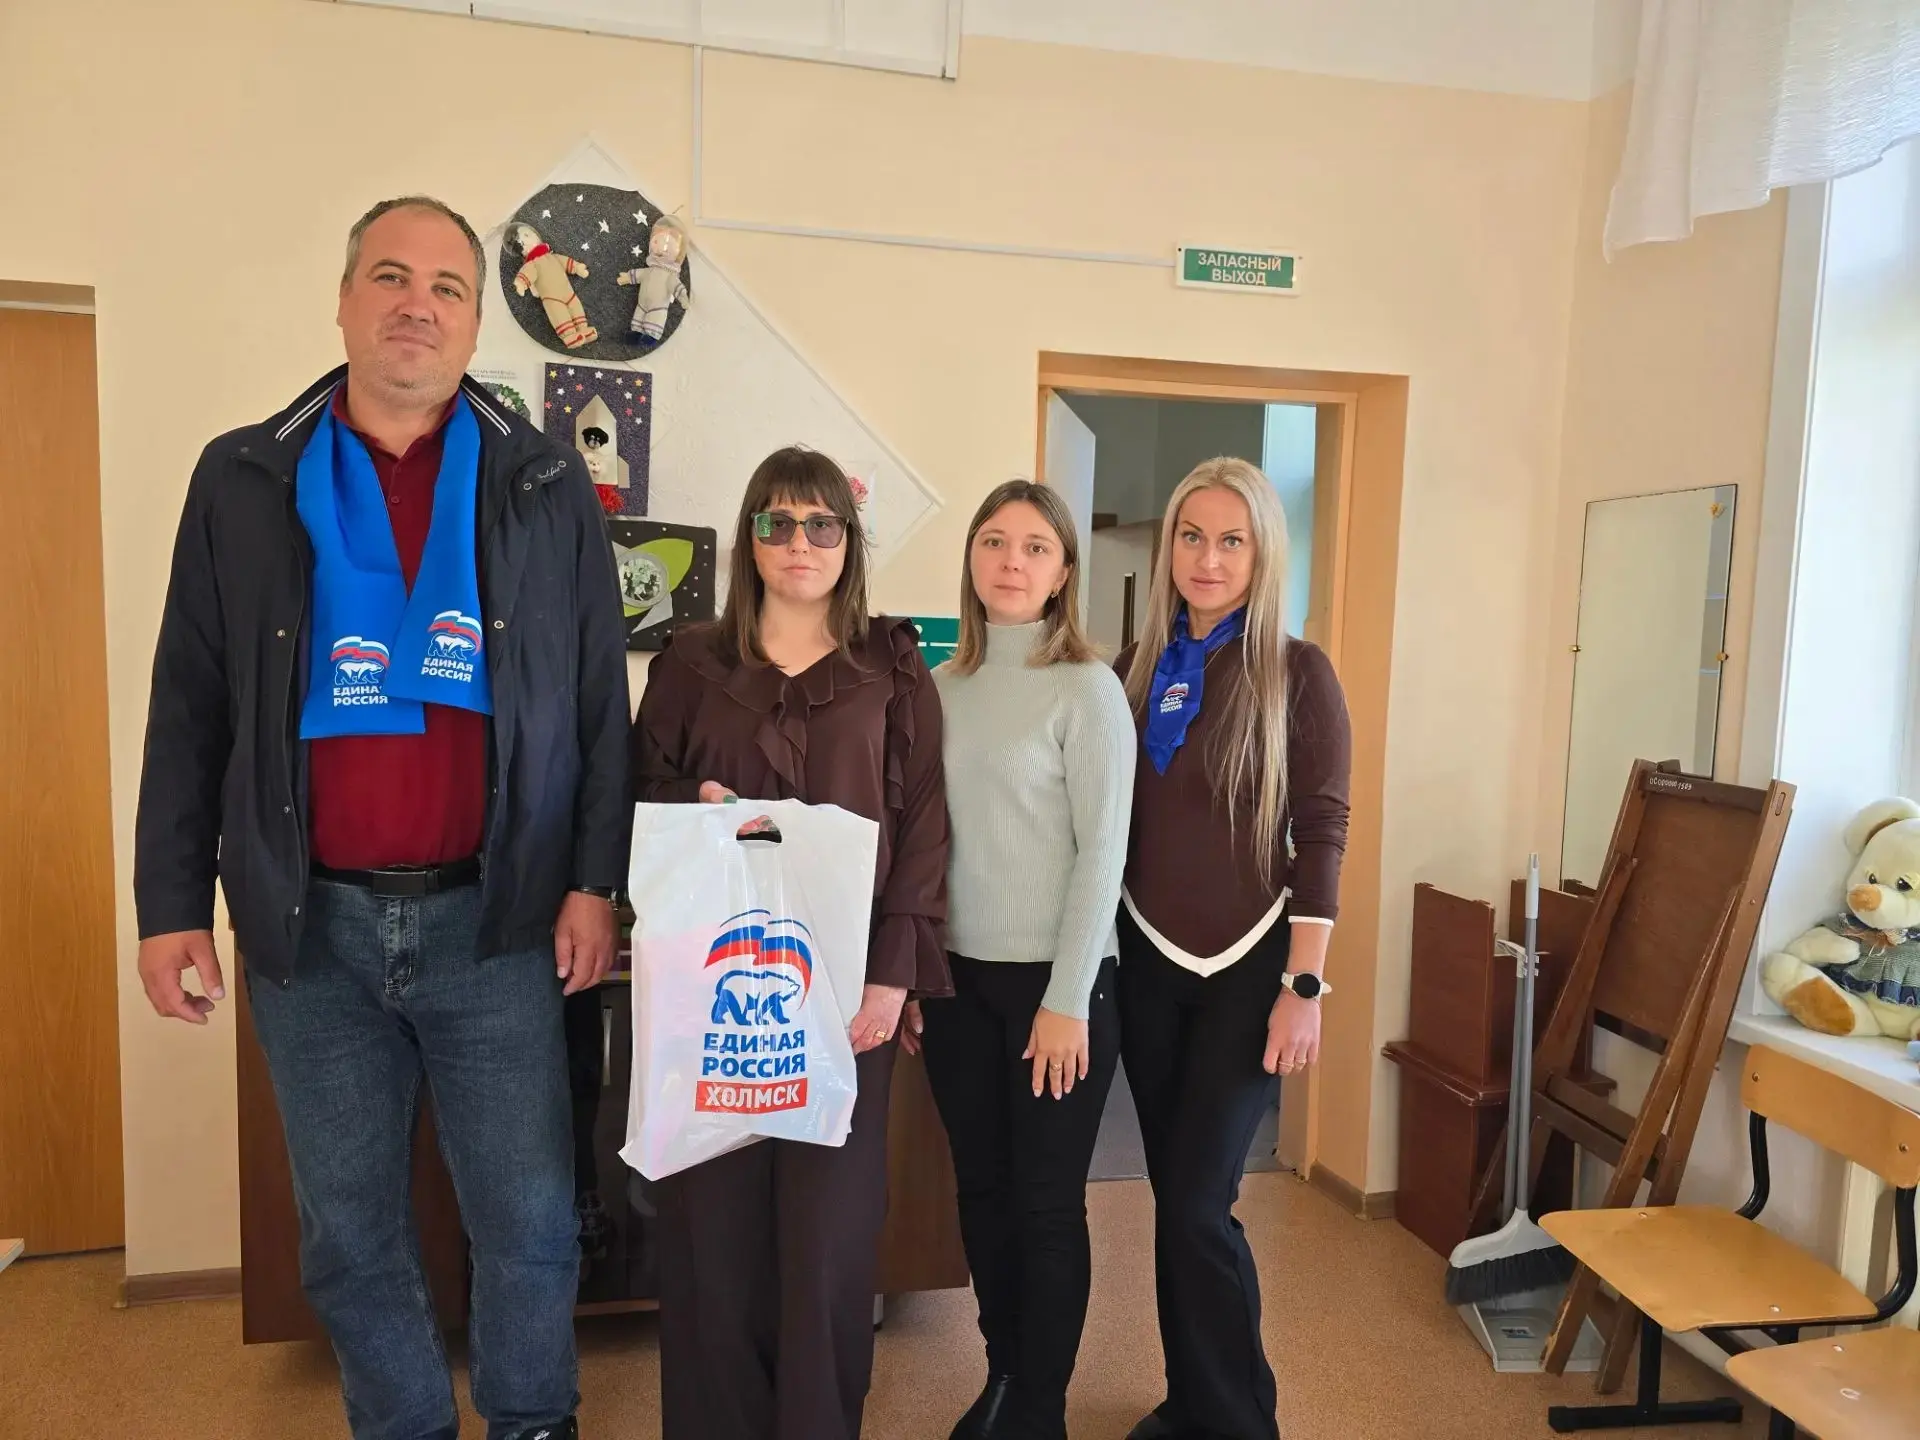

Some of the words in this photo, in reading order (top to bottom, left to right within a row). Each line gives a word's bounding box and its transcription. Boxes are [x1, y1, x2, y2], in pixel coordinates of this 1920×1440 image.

[1198, 252, 1282, 272] ЗАПАСНЫЙ
[1212, 268, 1267, 286] ВЫХОД
[423, 657, 474, 673] ЕДИНАЯ
[421, 667, 472, 683] РОССИЯ
[333, 685, 383, 697] ЕДИНА
[333, 695, 389, 707] РОССИЯ
[704, 1029, 805, 1055] ЕДИНАЯ
[702, 1052, 806, 1079] РОССИЯ
[705, 1083, 800, 1109] ХОЛМСК
